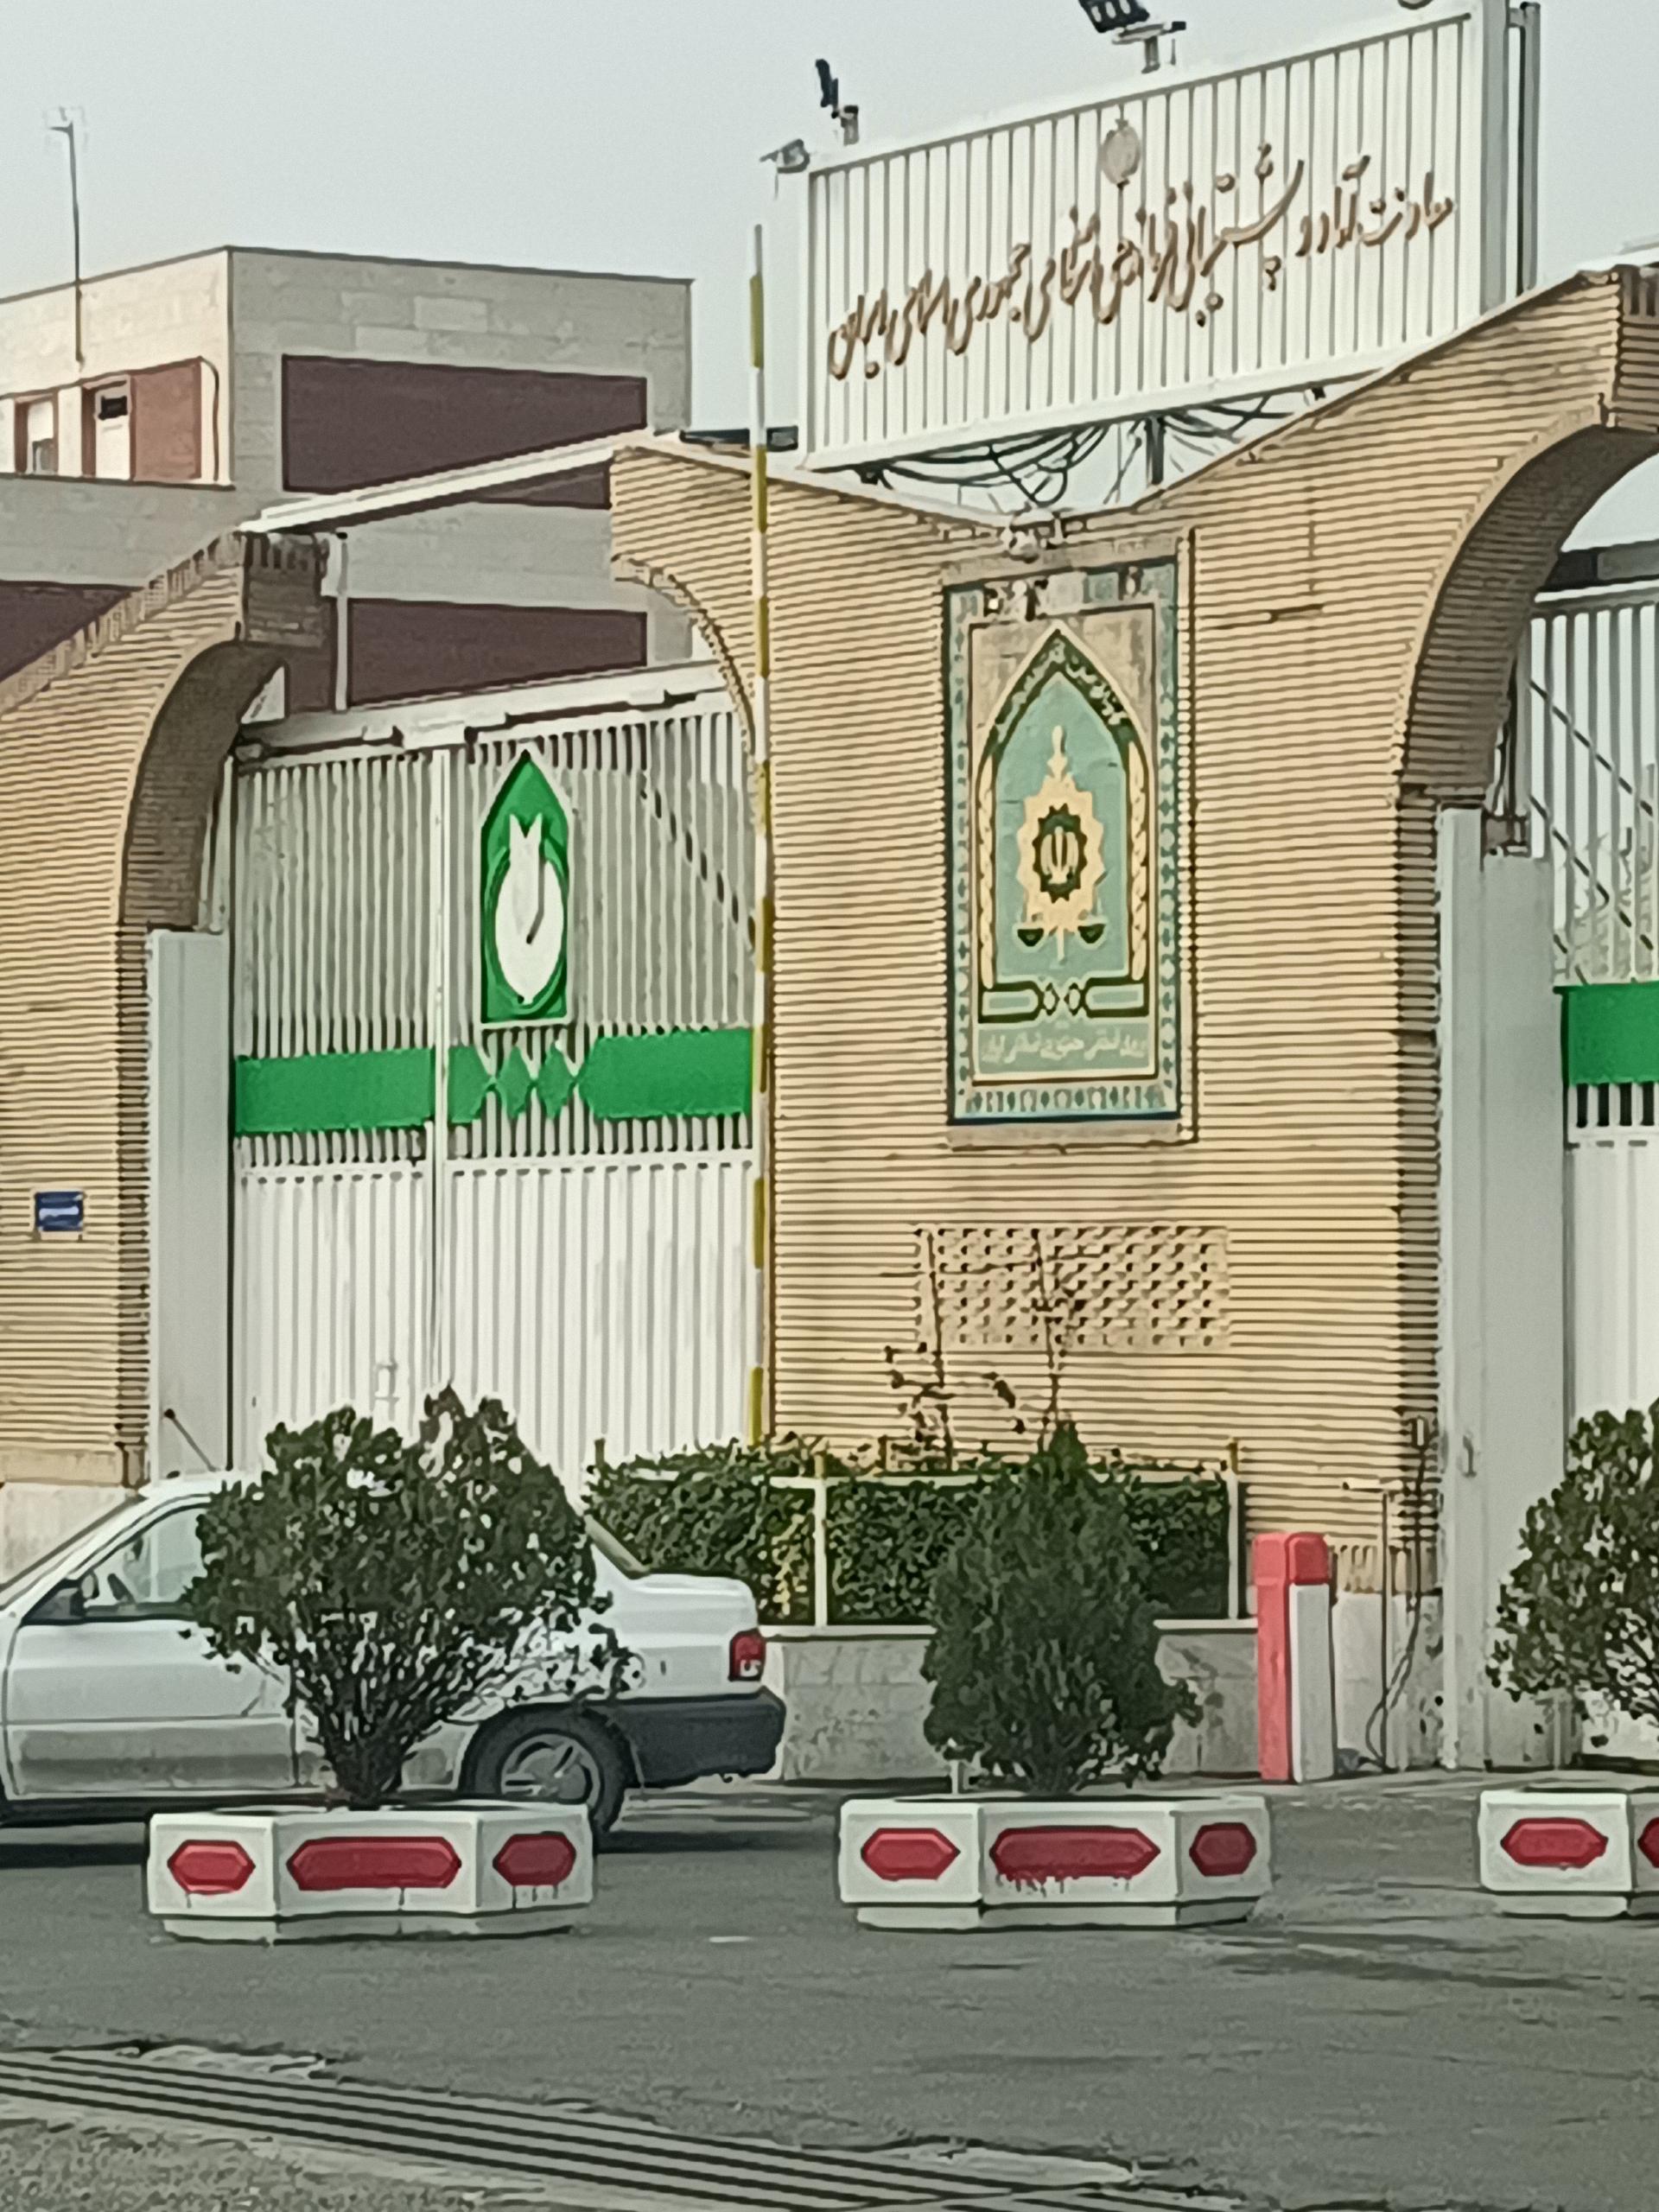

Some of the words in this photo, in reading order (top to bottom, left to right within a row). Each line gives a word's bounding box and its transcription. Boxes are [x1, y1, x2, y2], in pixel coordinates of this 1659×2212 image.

[1166, 142, 1305, 327] پشتیبانی
[1294, 215, 1313, 257] و
[1316, 155, 1371, 254] آماد
[1357, 171, 1454, 247] معاونت
[828, 288, 888, 380] ایران
[885, 268, 950, 366] اسلامی
[946, 243, 1032, 356] جمهوری
